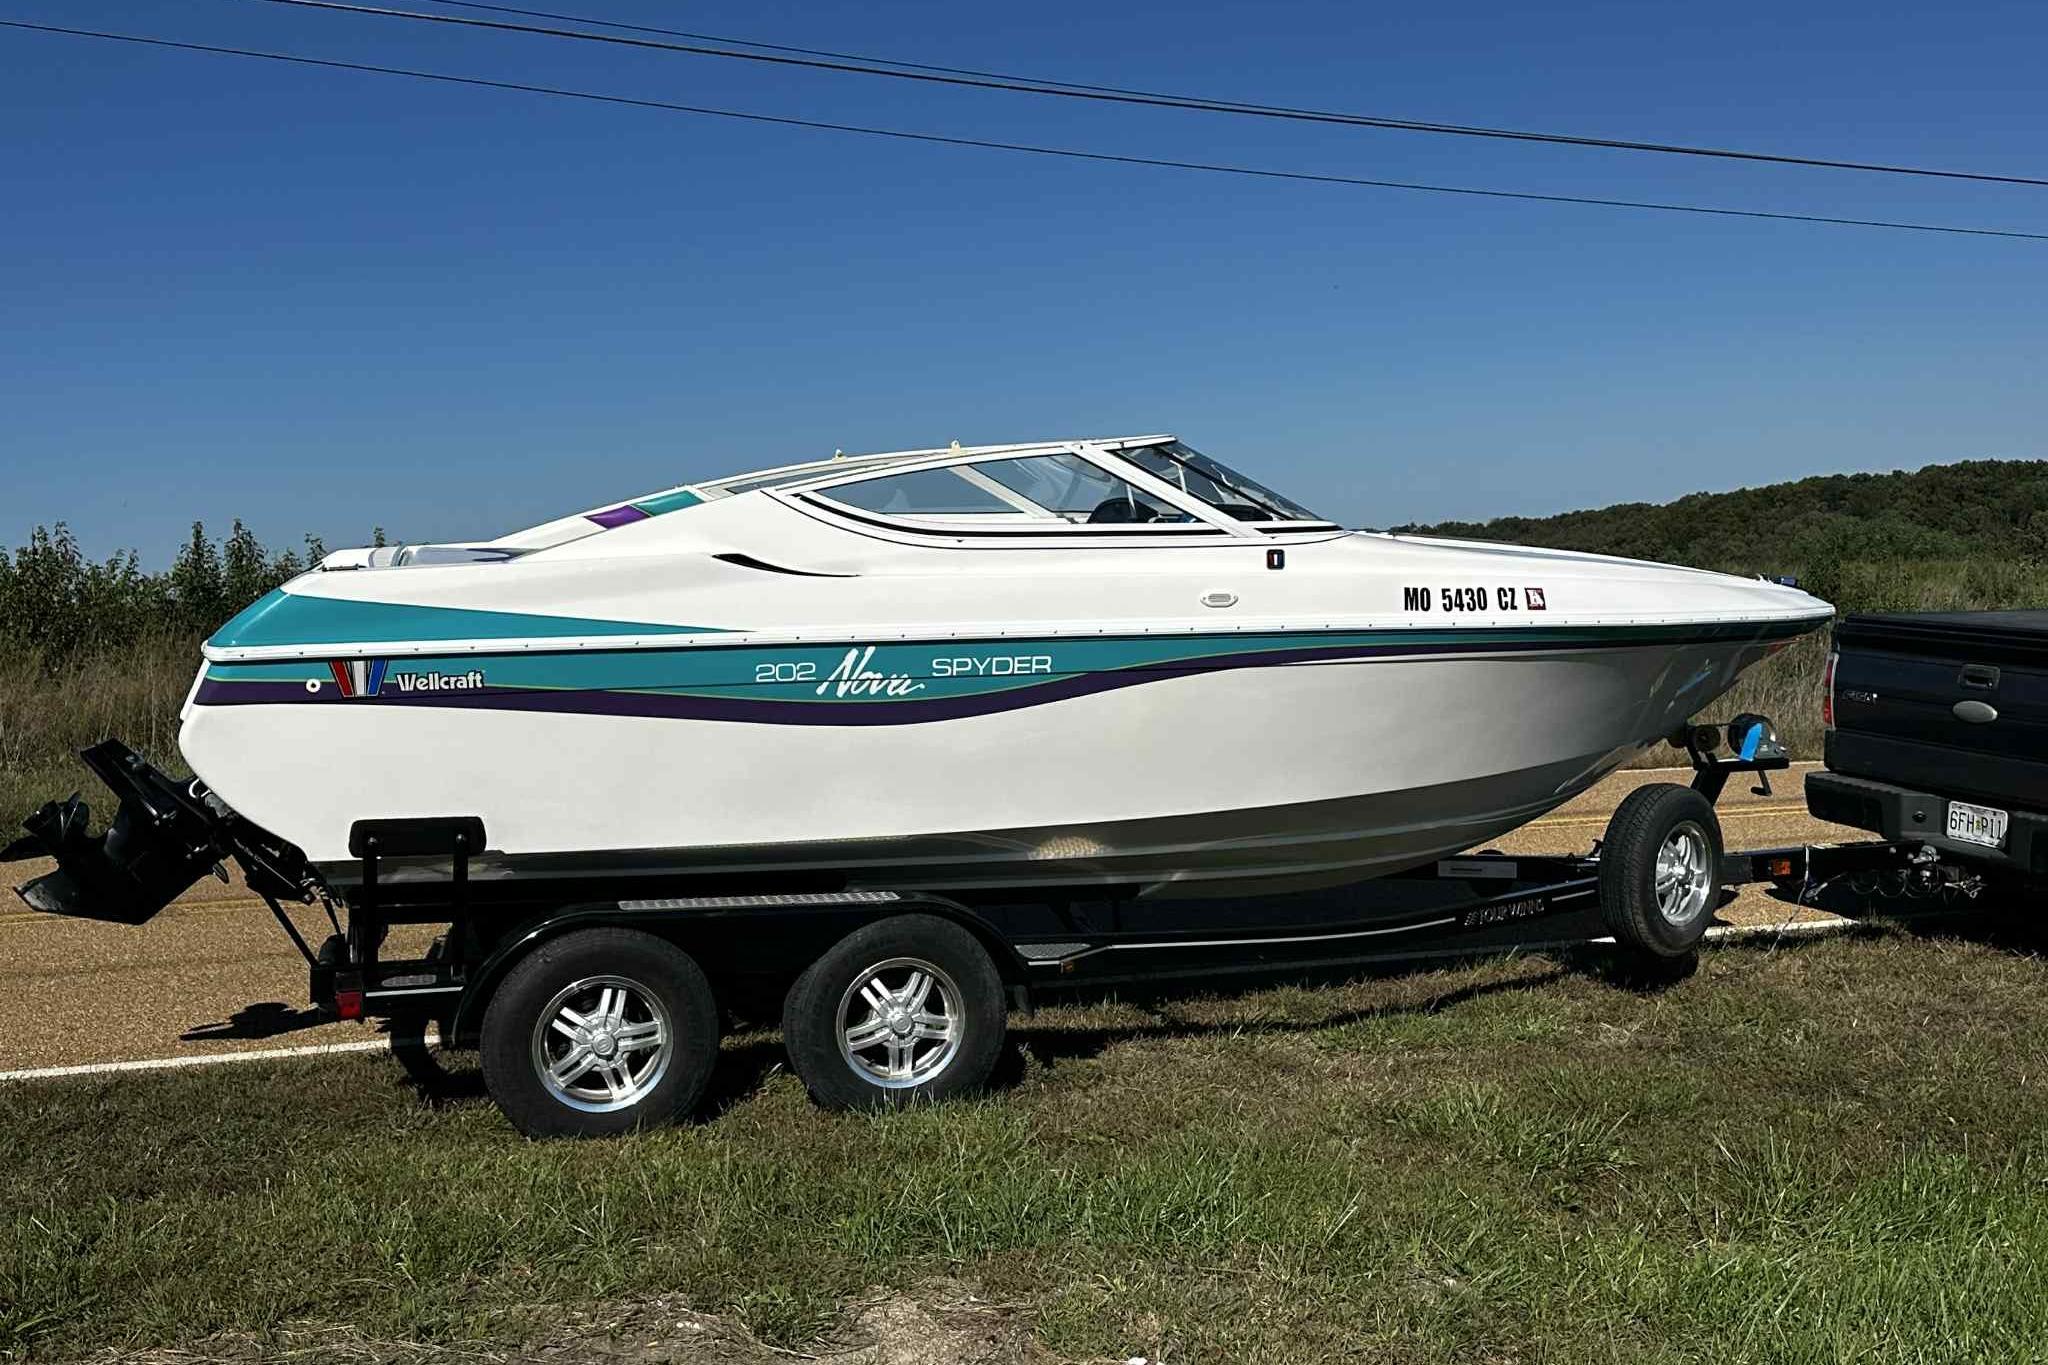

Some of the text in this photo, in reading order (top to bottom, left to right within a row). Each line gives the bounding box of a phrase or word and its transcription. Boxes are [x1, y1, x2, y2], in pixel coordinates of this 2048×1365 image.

[1404, 587, 1431, 611] MO
[1442, 587, 1488, 612] 5430
[1497, 587, 1518, 611] CZ
[396, 671, 483, 691] Wellcraft
[755, 646, 1052, 698] 202 Nova SPYDER
[1950, 810, 1975, 835] 6FH
